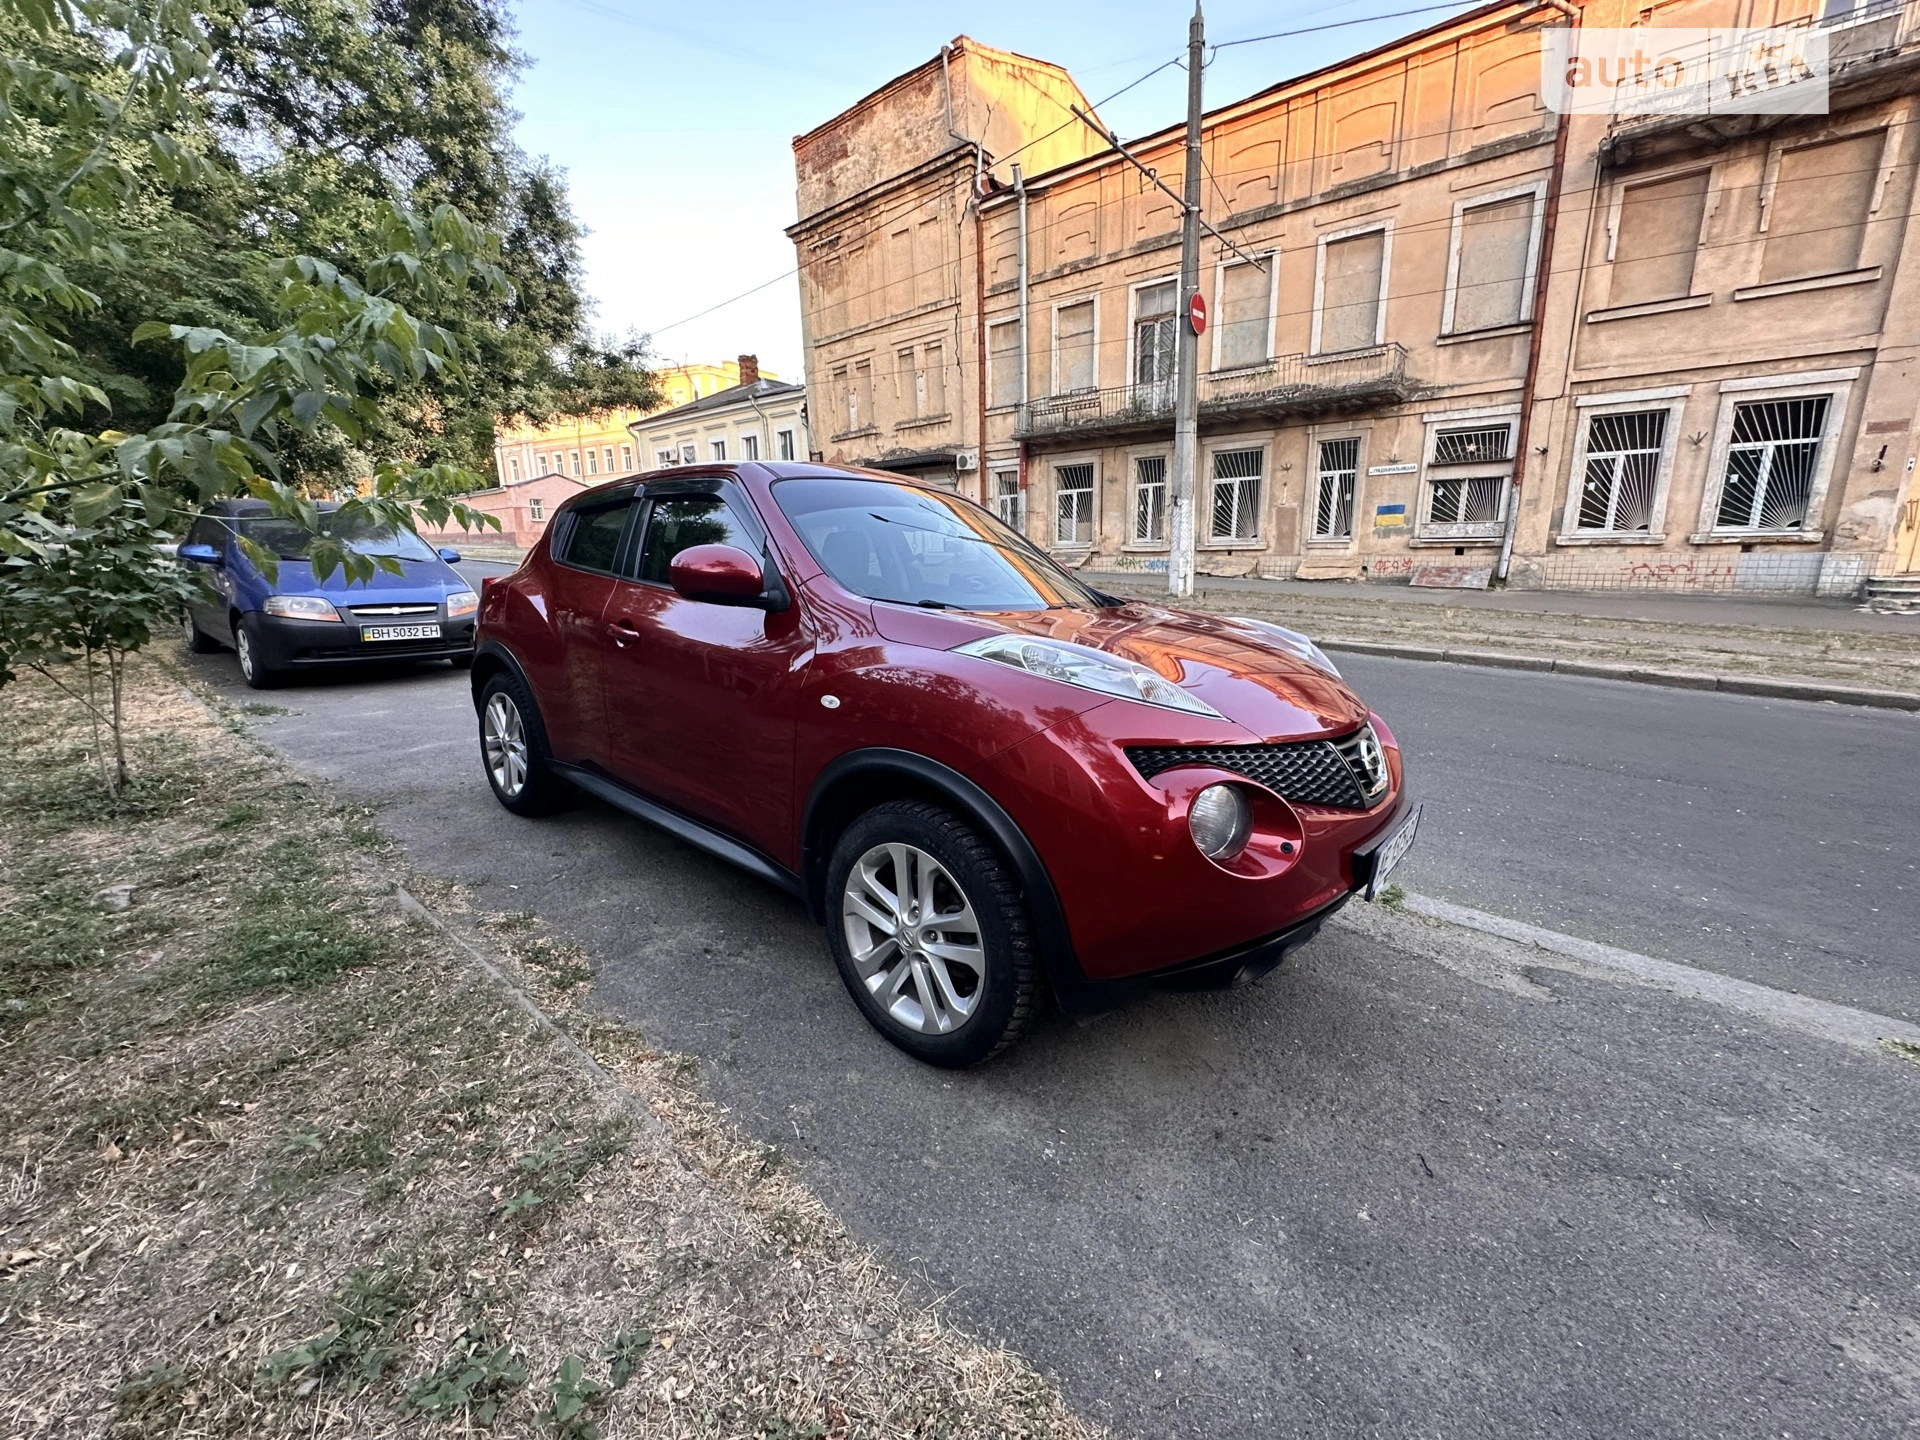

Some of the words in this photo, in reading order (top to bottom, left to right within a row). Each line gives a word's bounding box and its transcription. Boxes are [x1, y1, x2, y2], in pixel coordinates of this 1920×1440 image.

[372, 628, 390, 638] BH
[393, 627, 419, 637] 5032
[422, 626, 438, 636] EH
